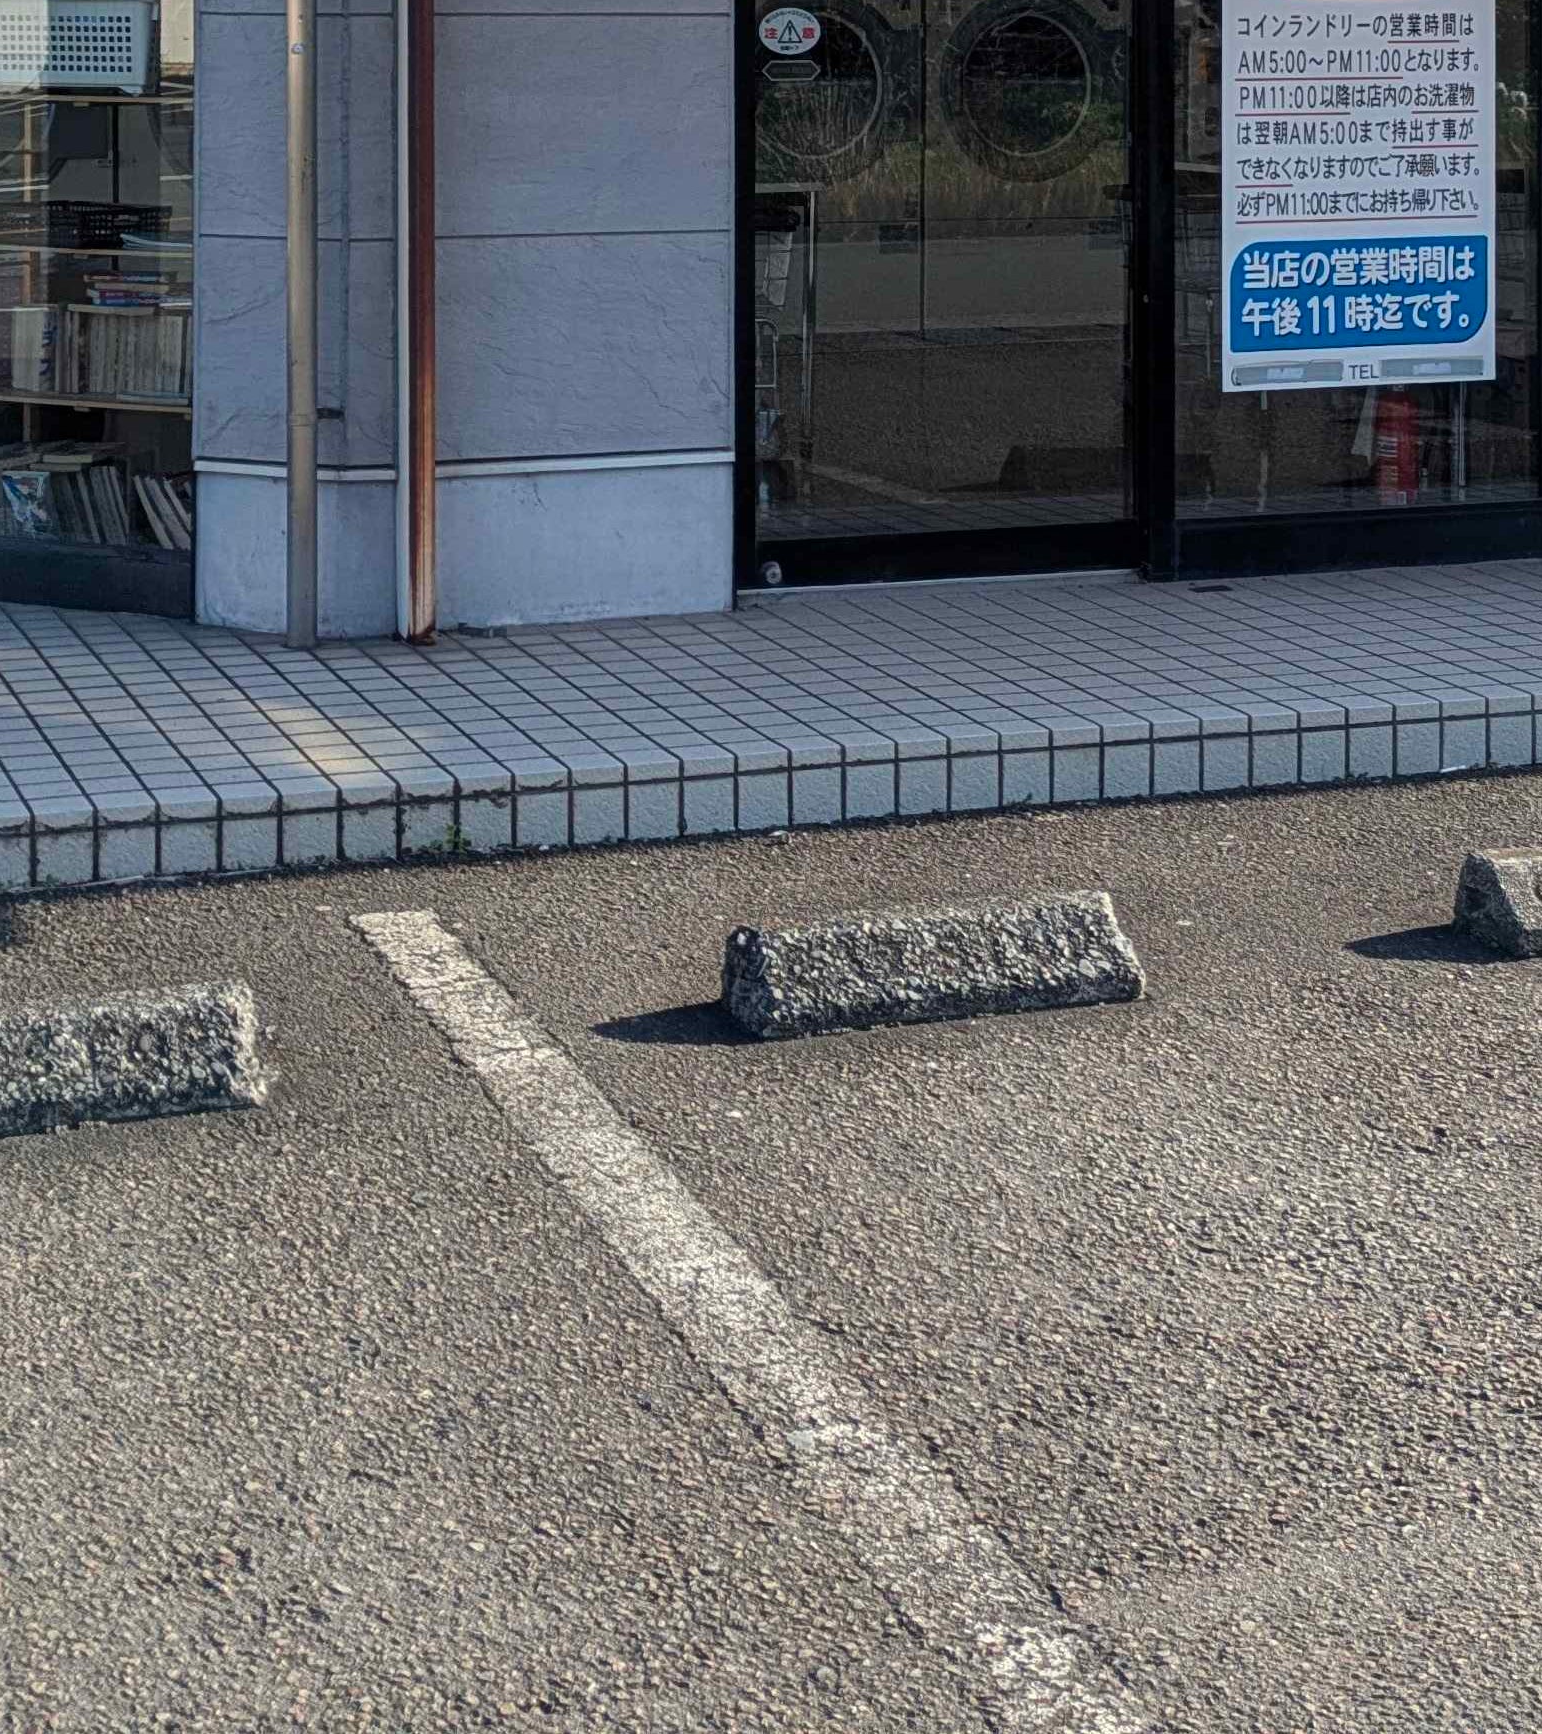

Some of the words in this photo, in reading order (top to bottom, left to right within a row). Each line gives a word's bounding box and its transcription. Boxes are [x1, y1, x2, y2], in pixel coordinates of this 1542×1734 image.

[1236, 12, 1475, 38] コインランドリーの営業時間は
[1239, 82, 1475, 110] PM11:00以降は店内のお洗濯物
[1236, 117, 1474, 146] は翌朝AM5:00まで持出す事が
[1236, 153, 1480, 180] できなくなりますのでご了承願います。
[1236, 188, 1479, 217] 必ずPM11:00までにお持ち帰り下さい。
[1242, 245, 1475, 289] 当店の営業時間は
[1240, 290, 1470, 337] 午後11時迄です。
[1348, 364, 1380, 380] TEL
